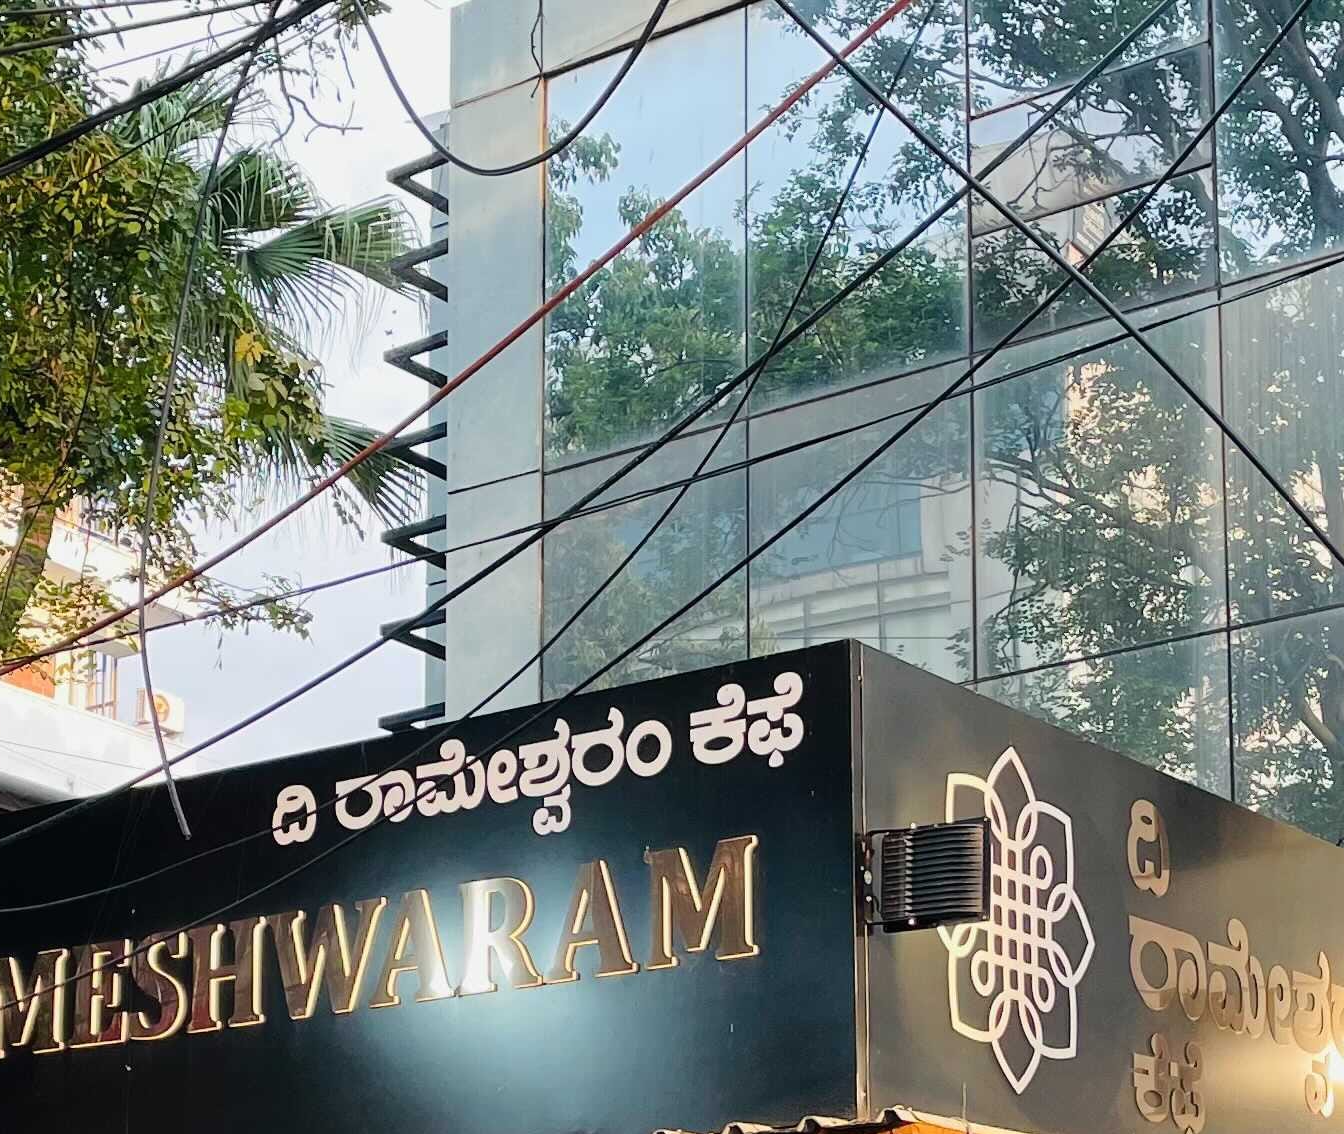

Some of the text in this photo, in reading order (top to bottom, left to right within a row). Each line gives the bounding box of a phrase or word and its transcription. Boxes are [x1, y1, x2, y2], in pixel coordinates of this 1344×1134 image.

[273, 671, 805, 847] ದಿ ರಾಮೇಶ್ವರಂ ಕೆಫೆ
[1128, 799, 1170, 896] ದಿ
